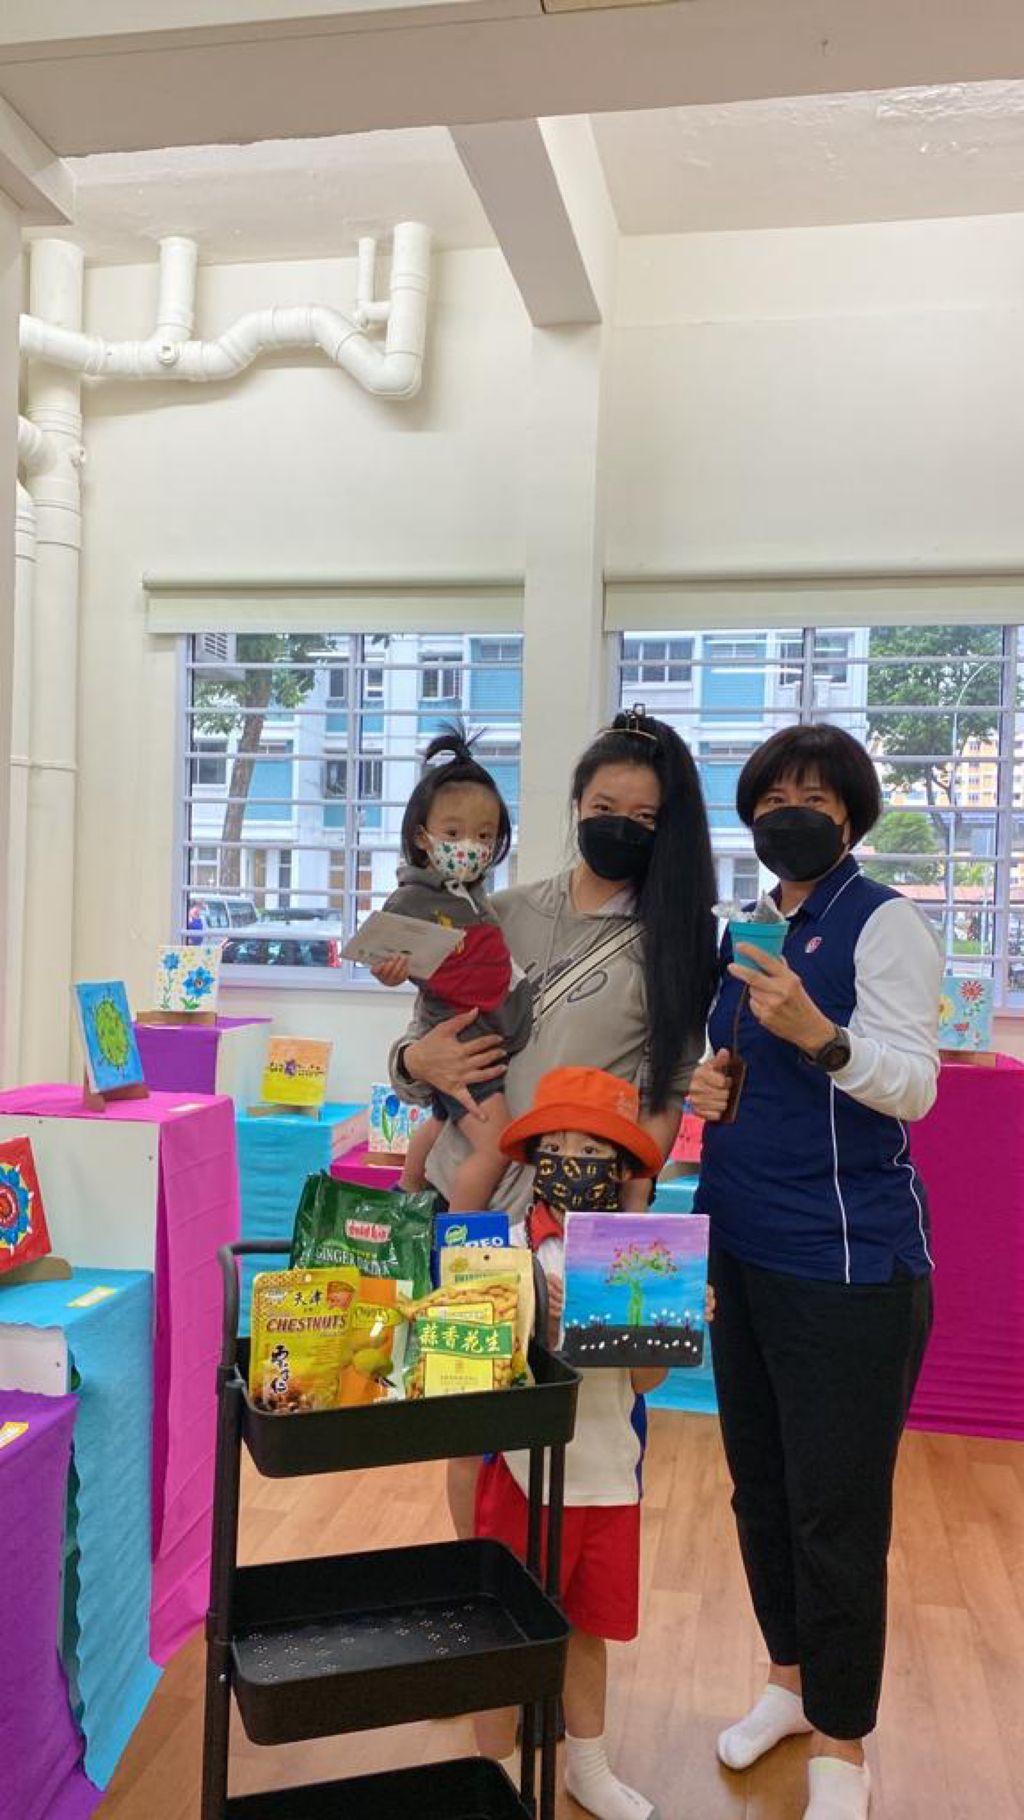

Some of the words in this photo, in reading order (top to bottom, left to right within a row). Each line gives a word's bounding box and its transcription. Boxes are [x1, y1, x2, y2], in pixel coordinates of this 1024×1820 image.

[293, 1289, 323, 1307] 天津
[266, 1314, 348, 1334] CHESTNUTS
[419, 1322, 502, 1354] 蒜香花生
